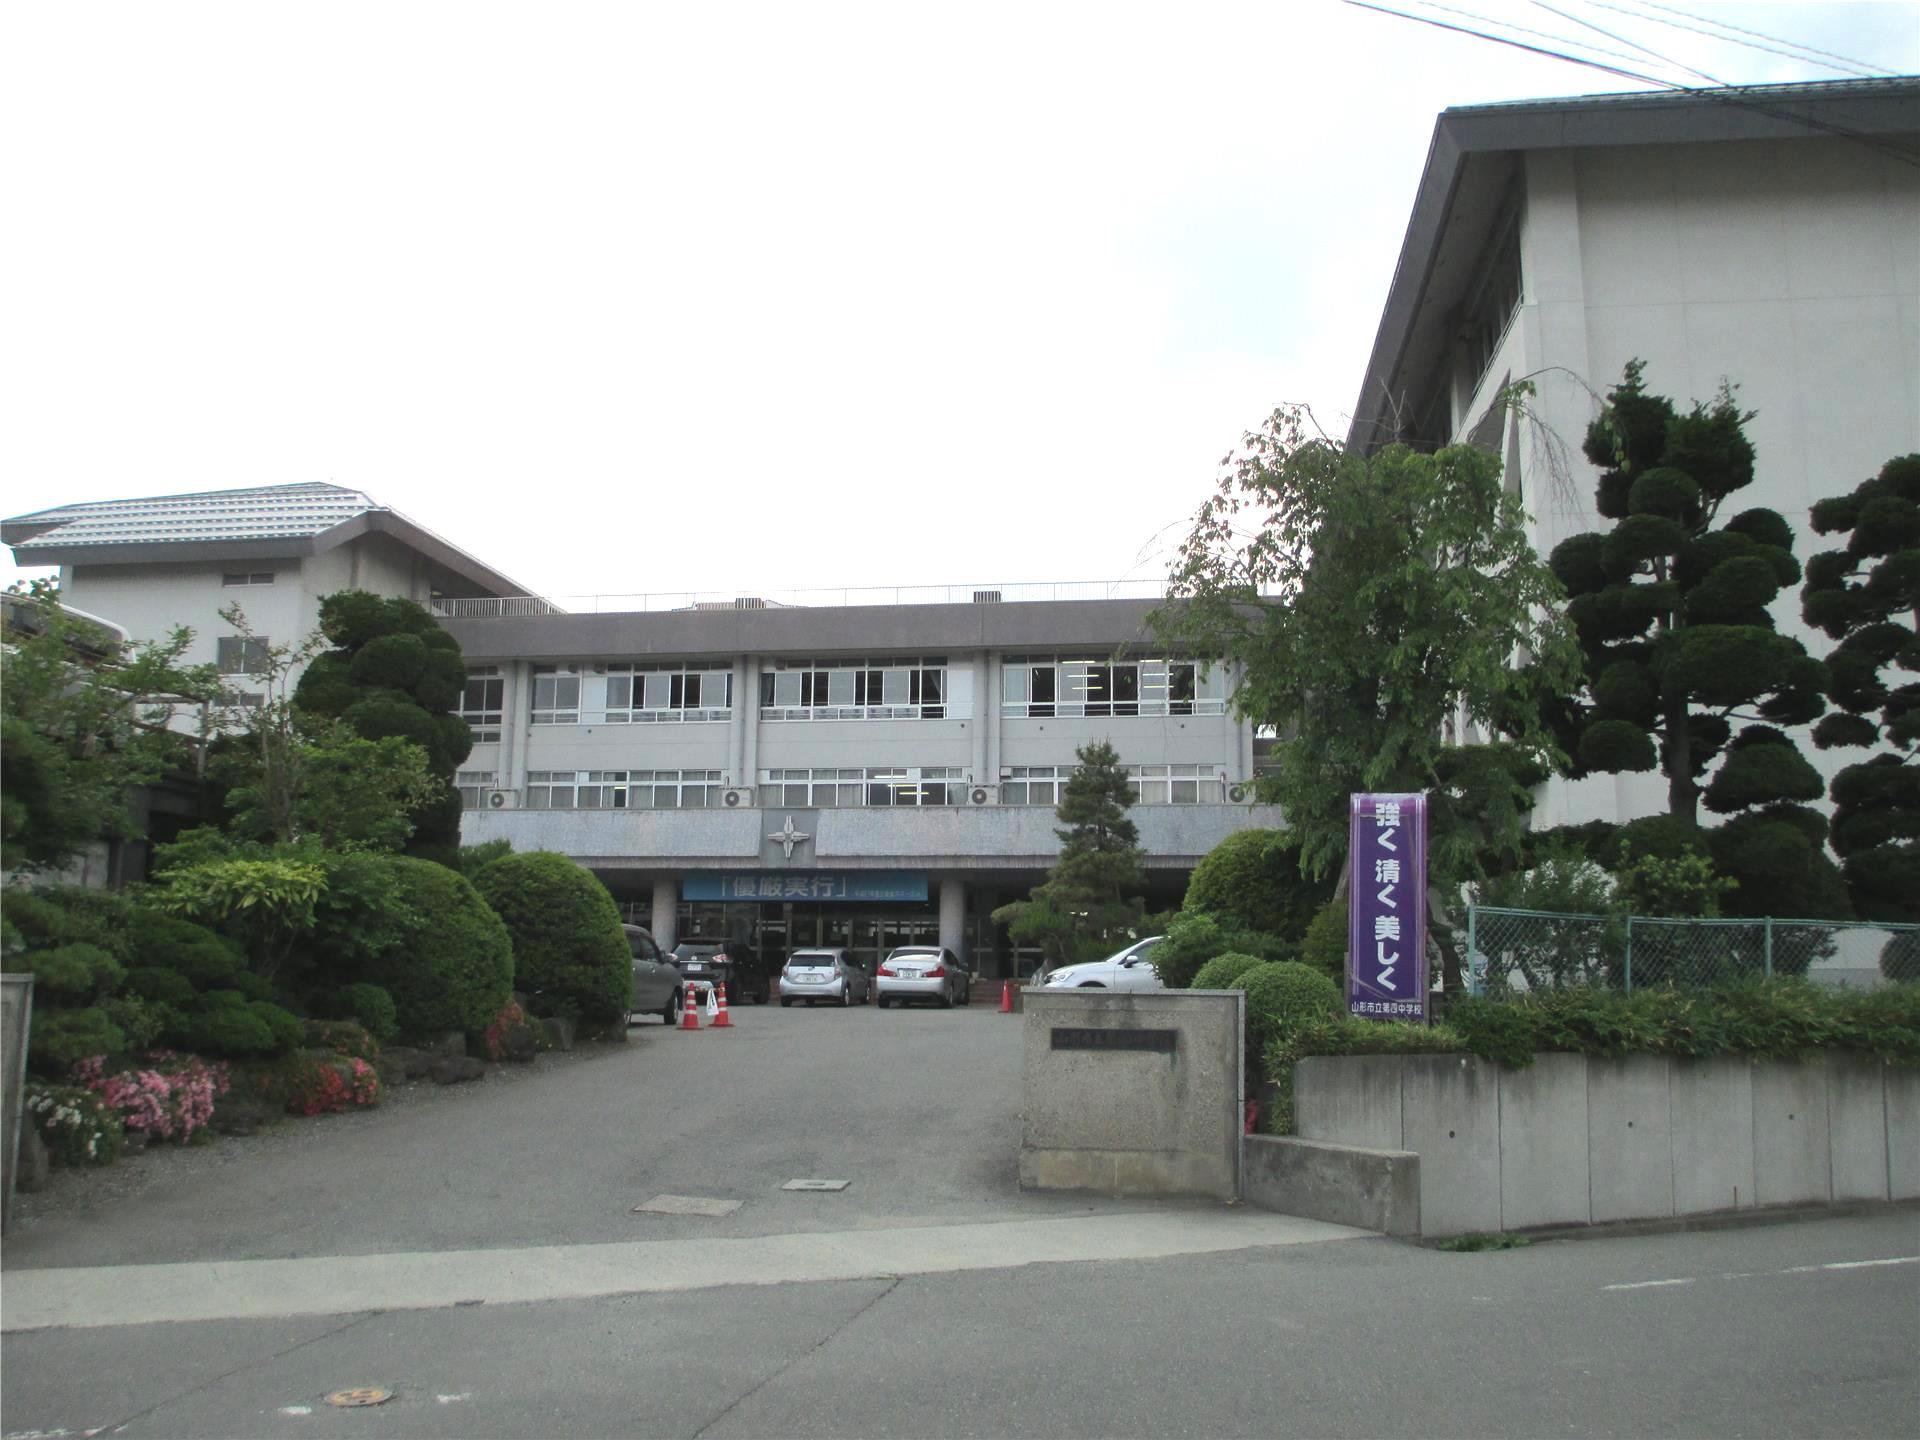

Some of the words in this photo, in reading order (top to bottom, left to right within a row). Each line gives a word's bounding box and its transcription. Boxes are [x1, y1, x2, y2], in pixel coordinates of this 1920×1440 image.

[1375, 802, 1401, 852] 強く
[1375, 859, 1401, 909] 清く
[1374, 915, 1401, 991] 美しく
[1351, 1001, 1423, 1015] 山形市立第四中学校
